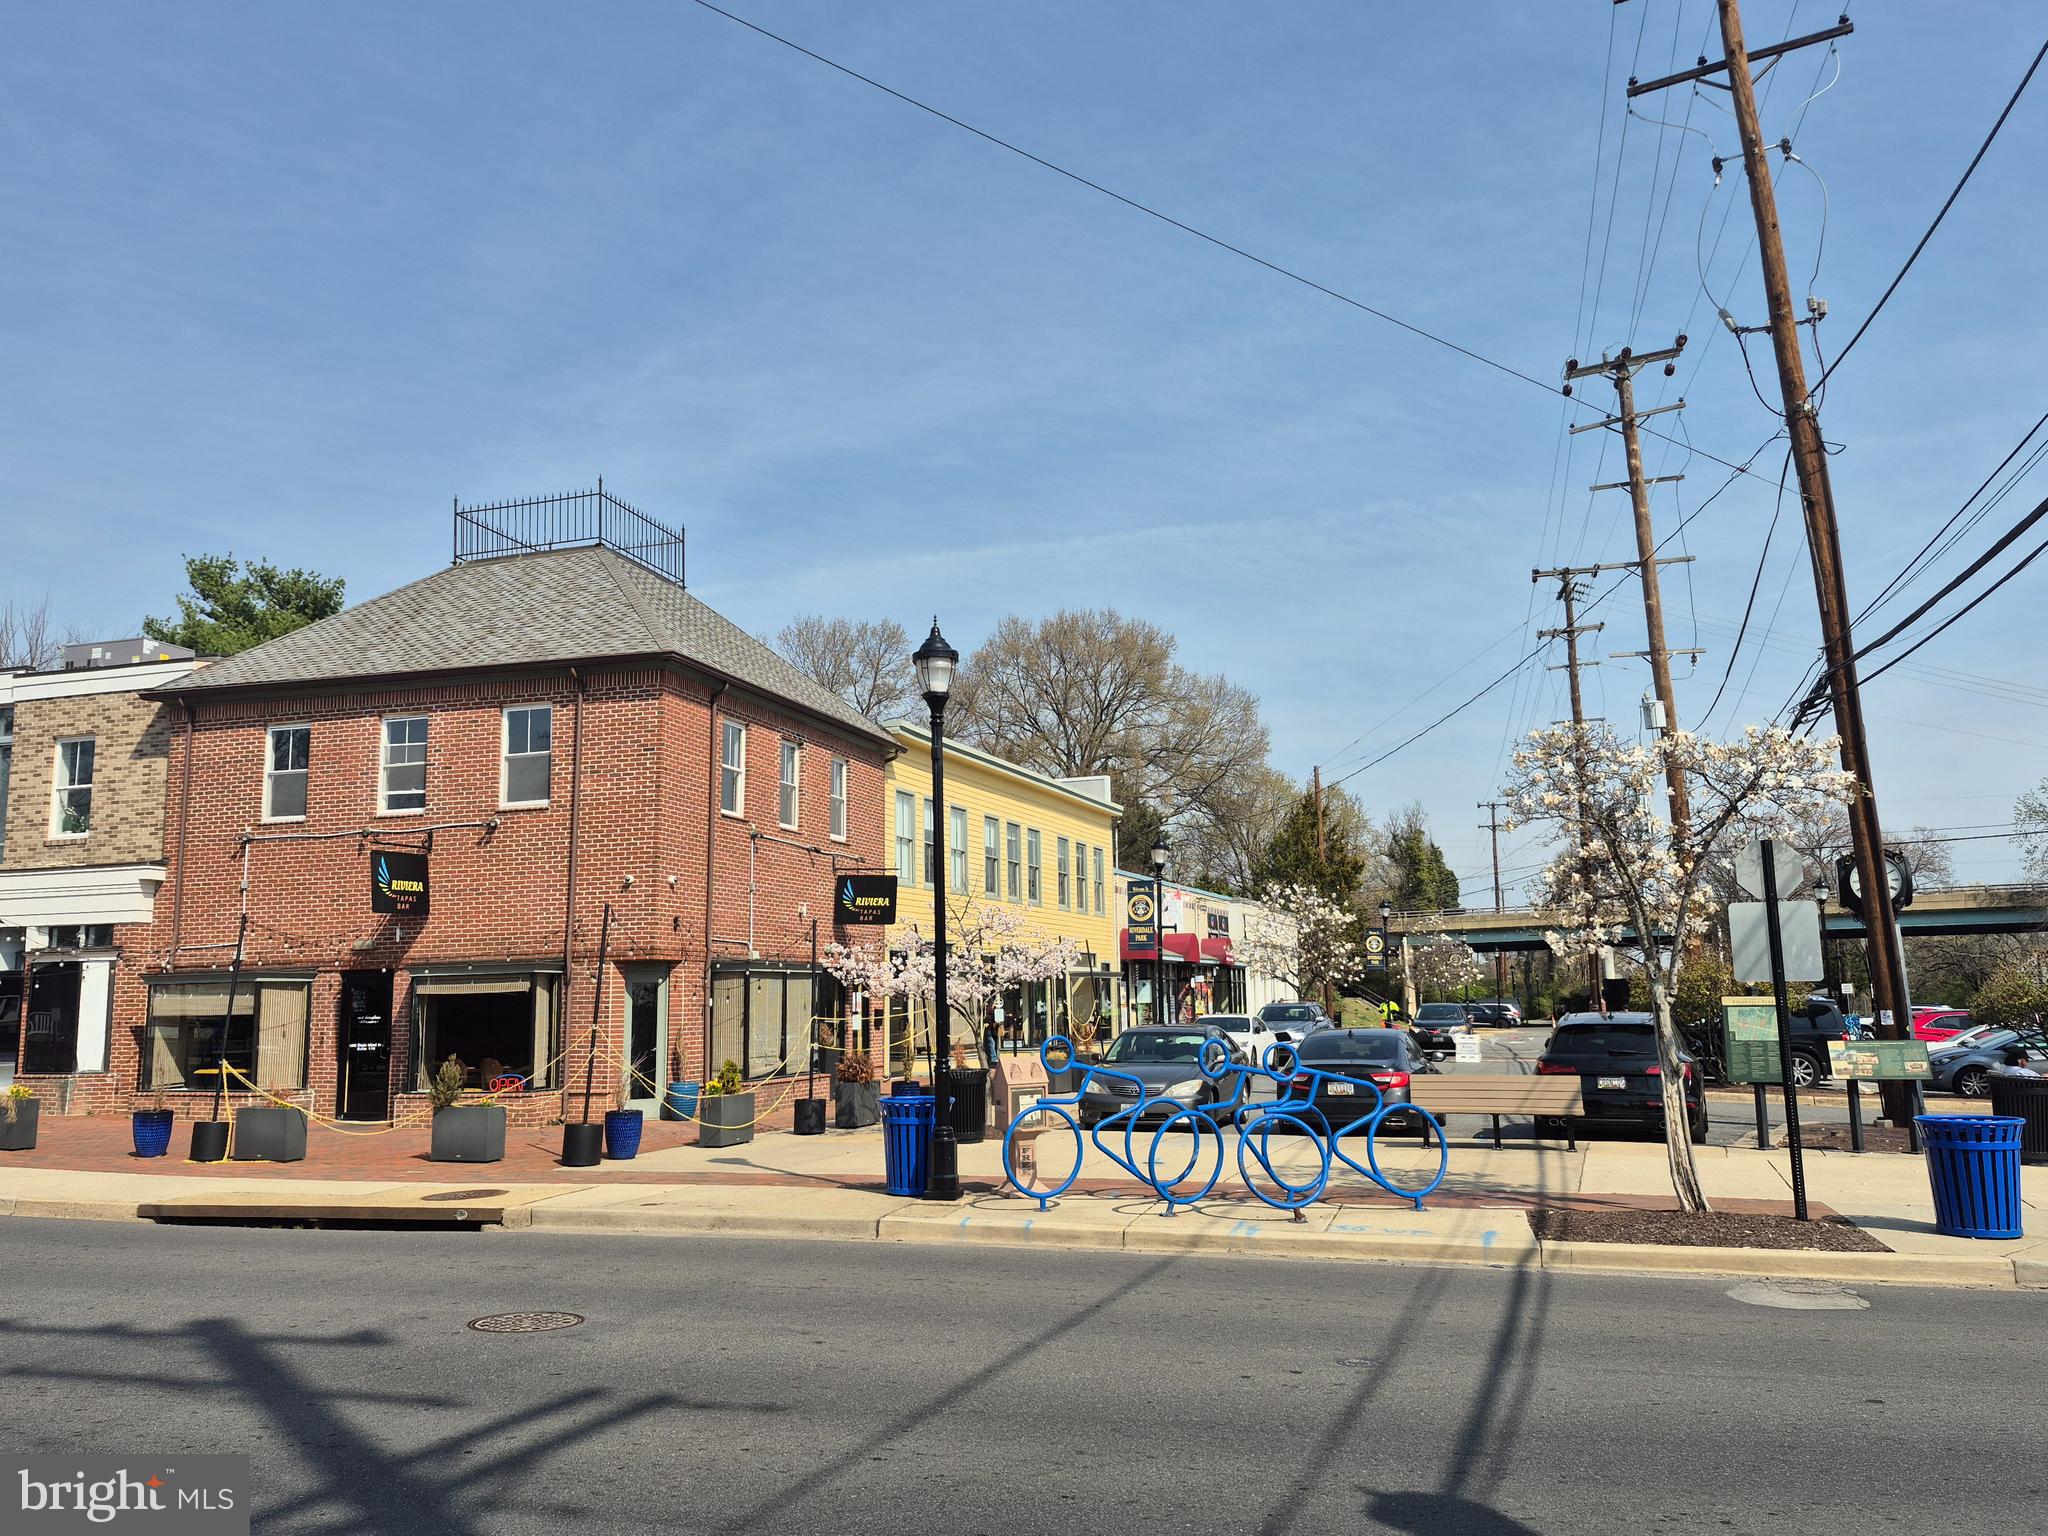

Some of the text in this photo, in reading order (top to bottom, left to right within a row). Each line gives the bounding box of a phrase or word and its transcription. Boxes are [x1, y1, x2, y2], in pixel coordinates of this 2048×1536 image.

[391, 880, 424, 892] RIVIERA
[855, 897, 890, 906] RIVIERA
[489, 1078, 523, 1092] OPEN
[1022, 1148, 1031, 1176] FREE
